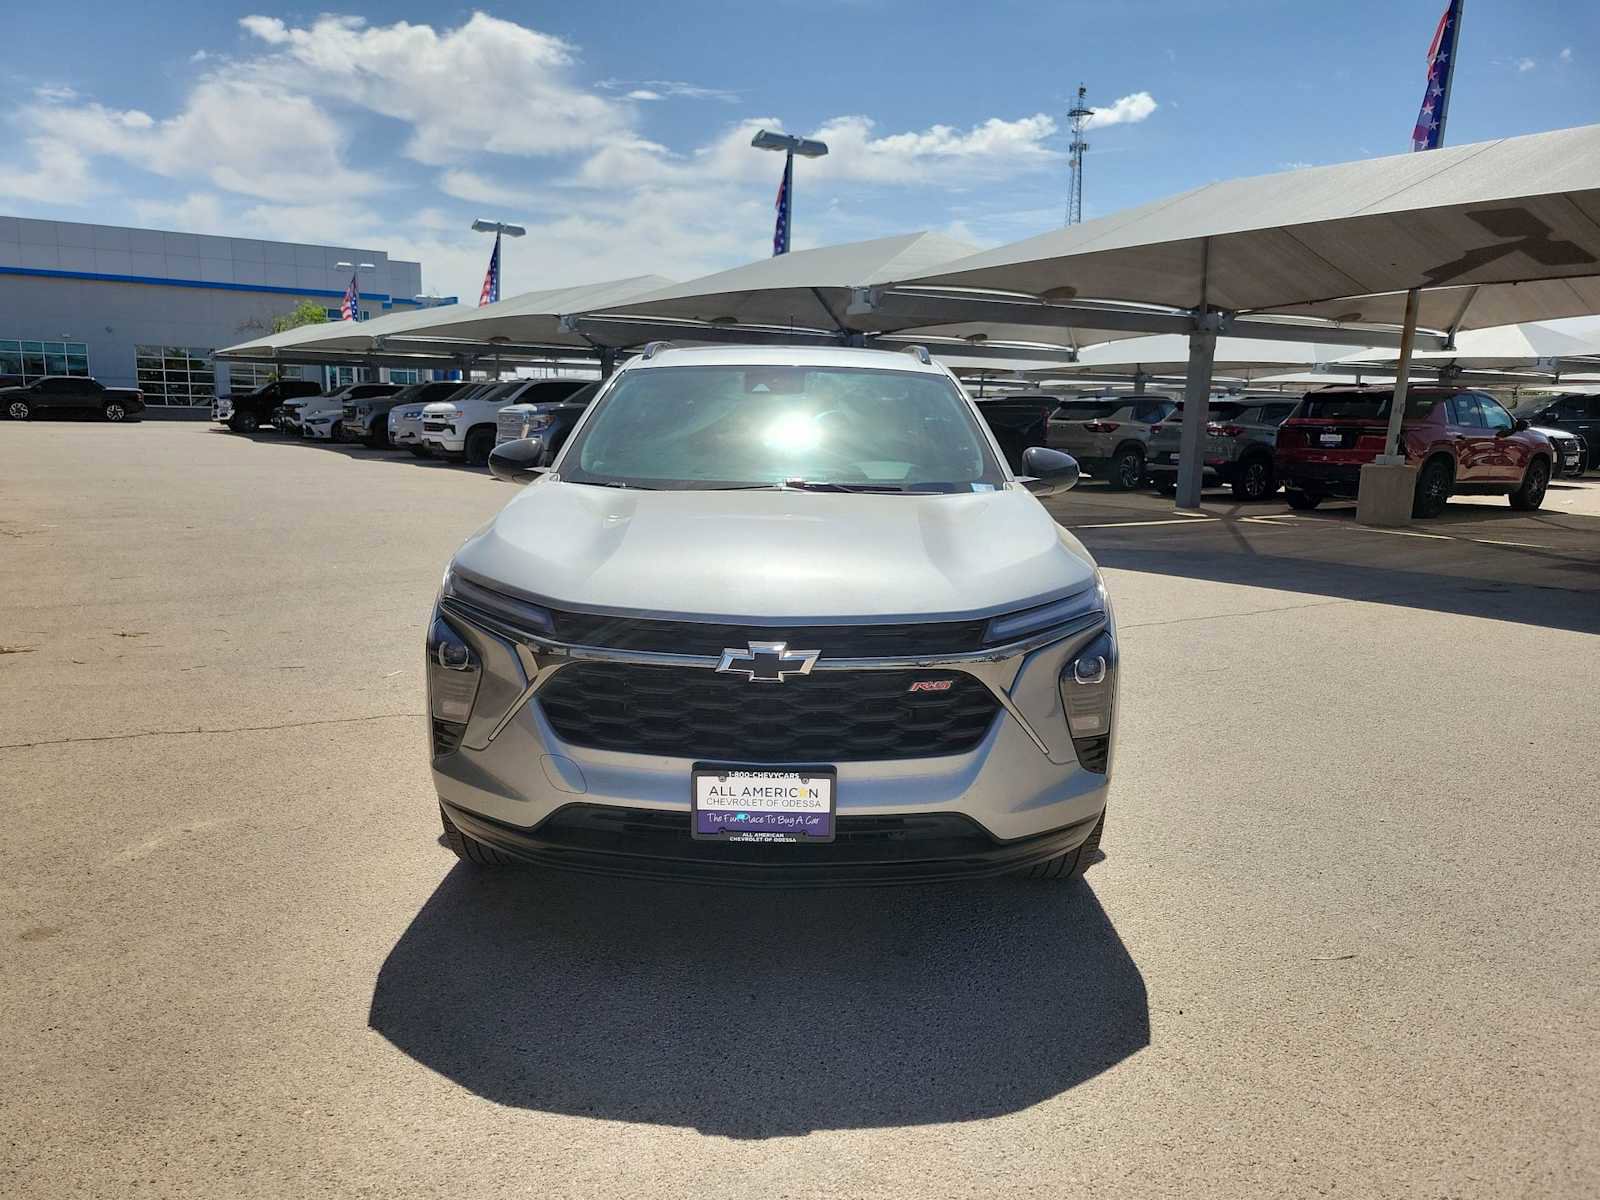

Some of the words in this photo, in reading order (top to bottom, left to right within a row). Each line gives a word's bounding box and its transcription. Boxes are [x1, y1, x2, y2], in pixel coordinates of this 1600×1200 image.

[909, 680, 953, 692] RS
[728, 771, 799, 779] 1-800-CHEVYCARS
[709, 785, 737, 796] ALL
[707, 797, 764, 807] CHEVROLET
[766, 799, 779, 807] OF
[781, 799, 821, 808] ODESSA
[706, 812, 723, 823] The
[741, 812, 764, 824] Place
[765, 814, 776, 824] To
[777, 815, 795, 828] Buy
[795, 815, 804, 825] A
[805, 815, 820, 825] Car
